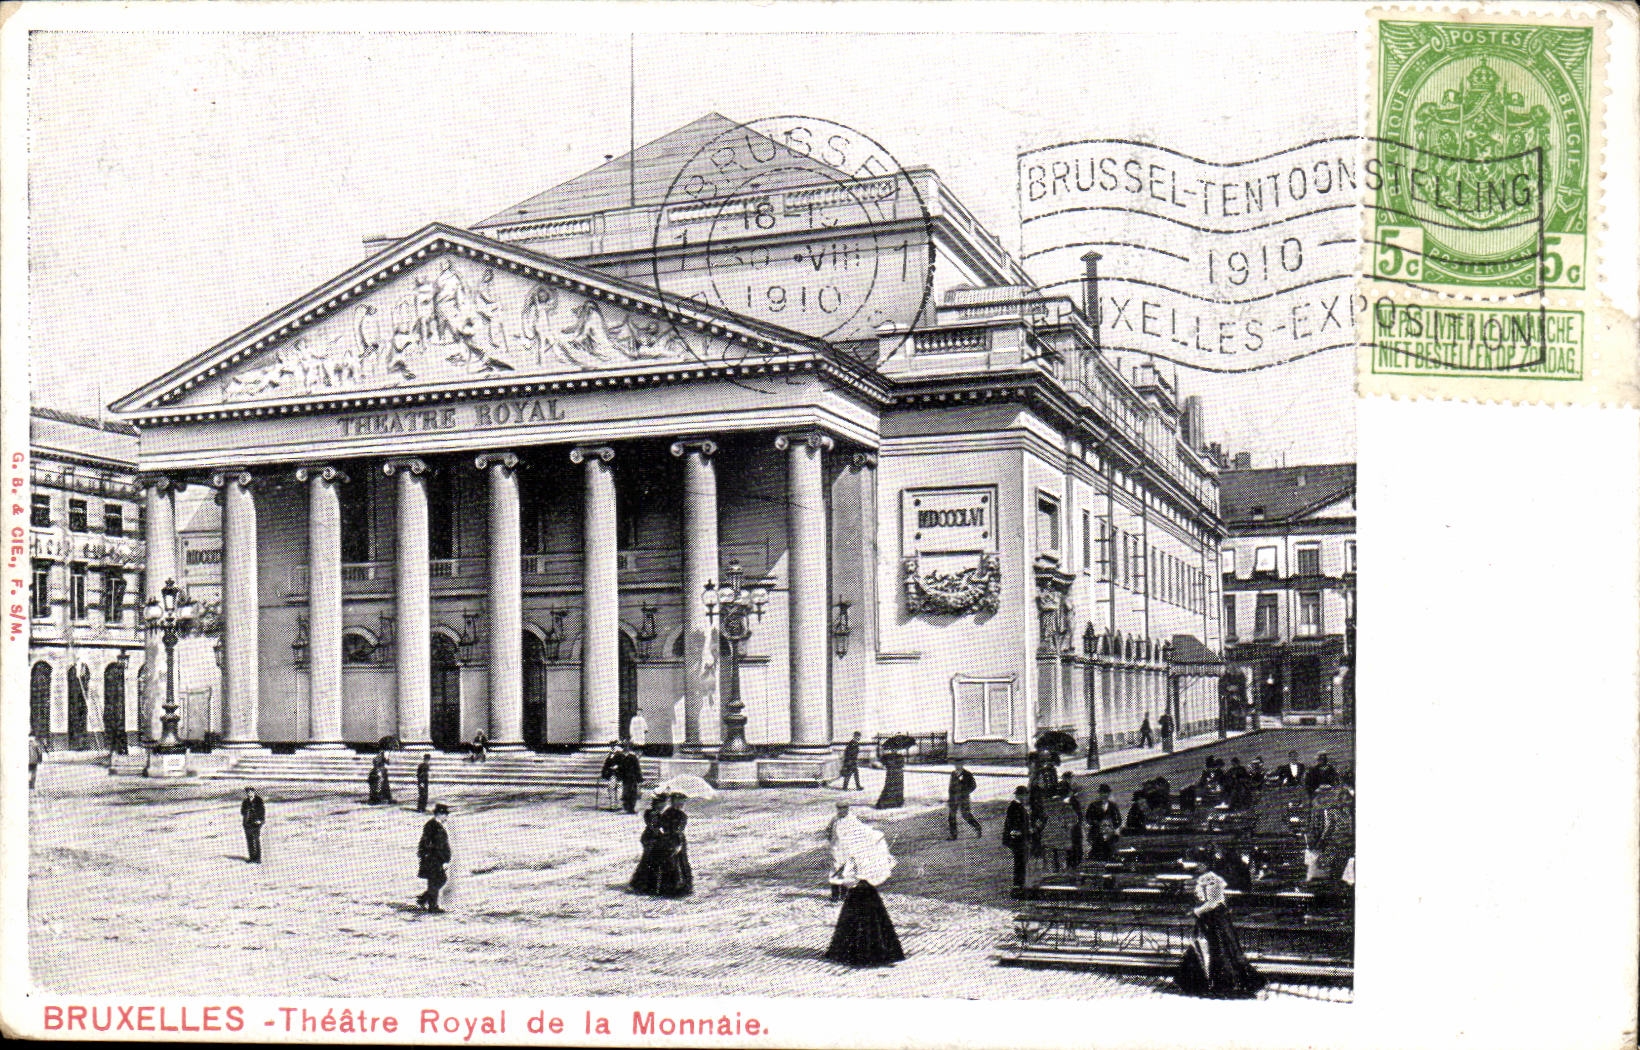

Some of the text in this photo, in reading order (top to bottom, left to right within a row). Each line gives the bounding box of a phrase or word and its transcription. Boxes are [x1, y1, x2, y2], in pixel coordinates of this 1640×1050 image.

[1451, 29, 1522, 47] POSTES
[1558, 92, 1581, 170] BELGIE
[1208, 236, 1303, 286] 1910
[1428, 246, 1533, 274] POSTERIJEN
[746, 285, 841, 314] 1910
[1378, 308, 1396, 338] NE
[1398, 309, 1423, 338] PAS
[1479, 313, 1499, 342] LE
[1378, 340, 1412, 368] NIET
[1414, 341, 1494, 371] BESTELLEN
[1495, 345, 1516, 372] OP
[337, 398, 565, 438] THEATRE ROYAL
